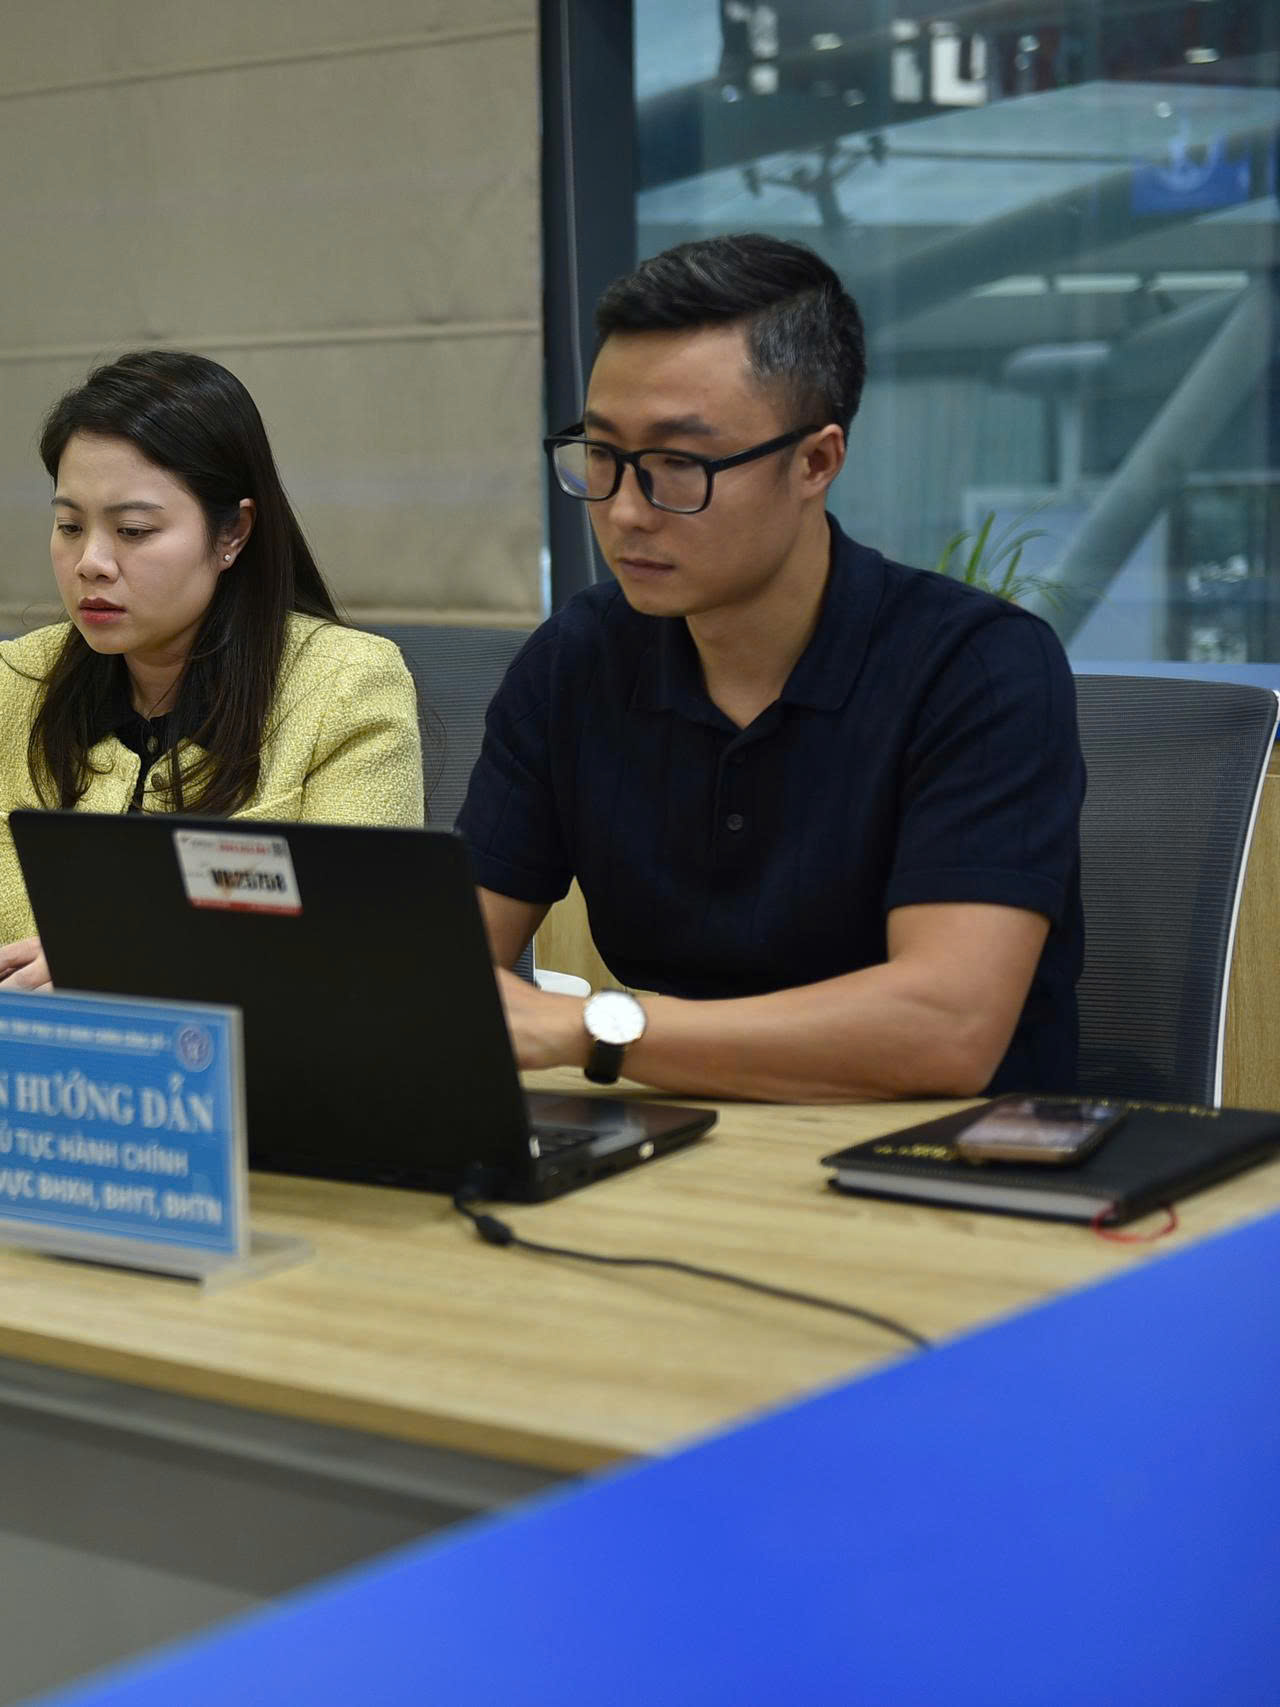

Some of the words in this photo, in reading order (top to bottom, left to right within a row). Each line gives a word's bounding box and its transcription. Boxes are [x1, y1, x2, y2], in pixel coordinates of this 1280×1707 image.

[16, 1068, 136, 1126] HƯỚNG
[15, 1127, 56, 1163] TỤC
[58, 1131, 119, 1168] HÀNH
[122, 1139, 189, 1178] CHÍNH
